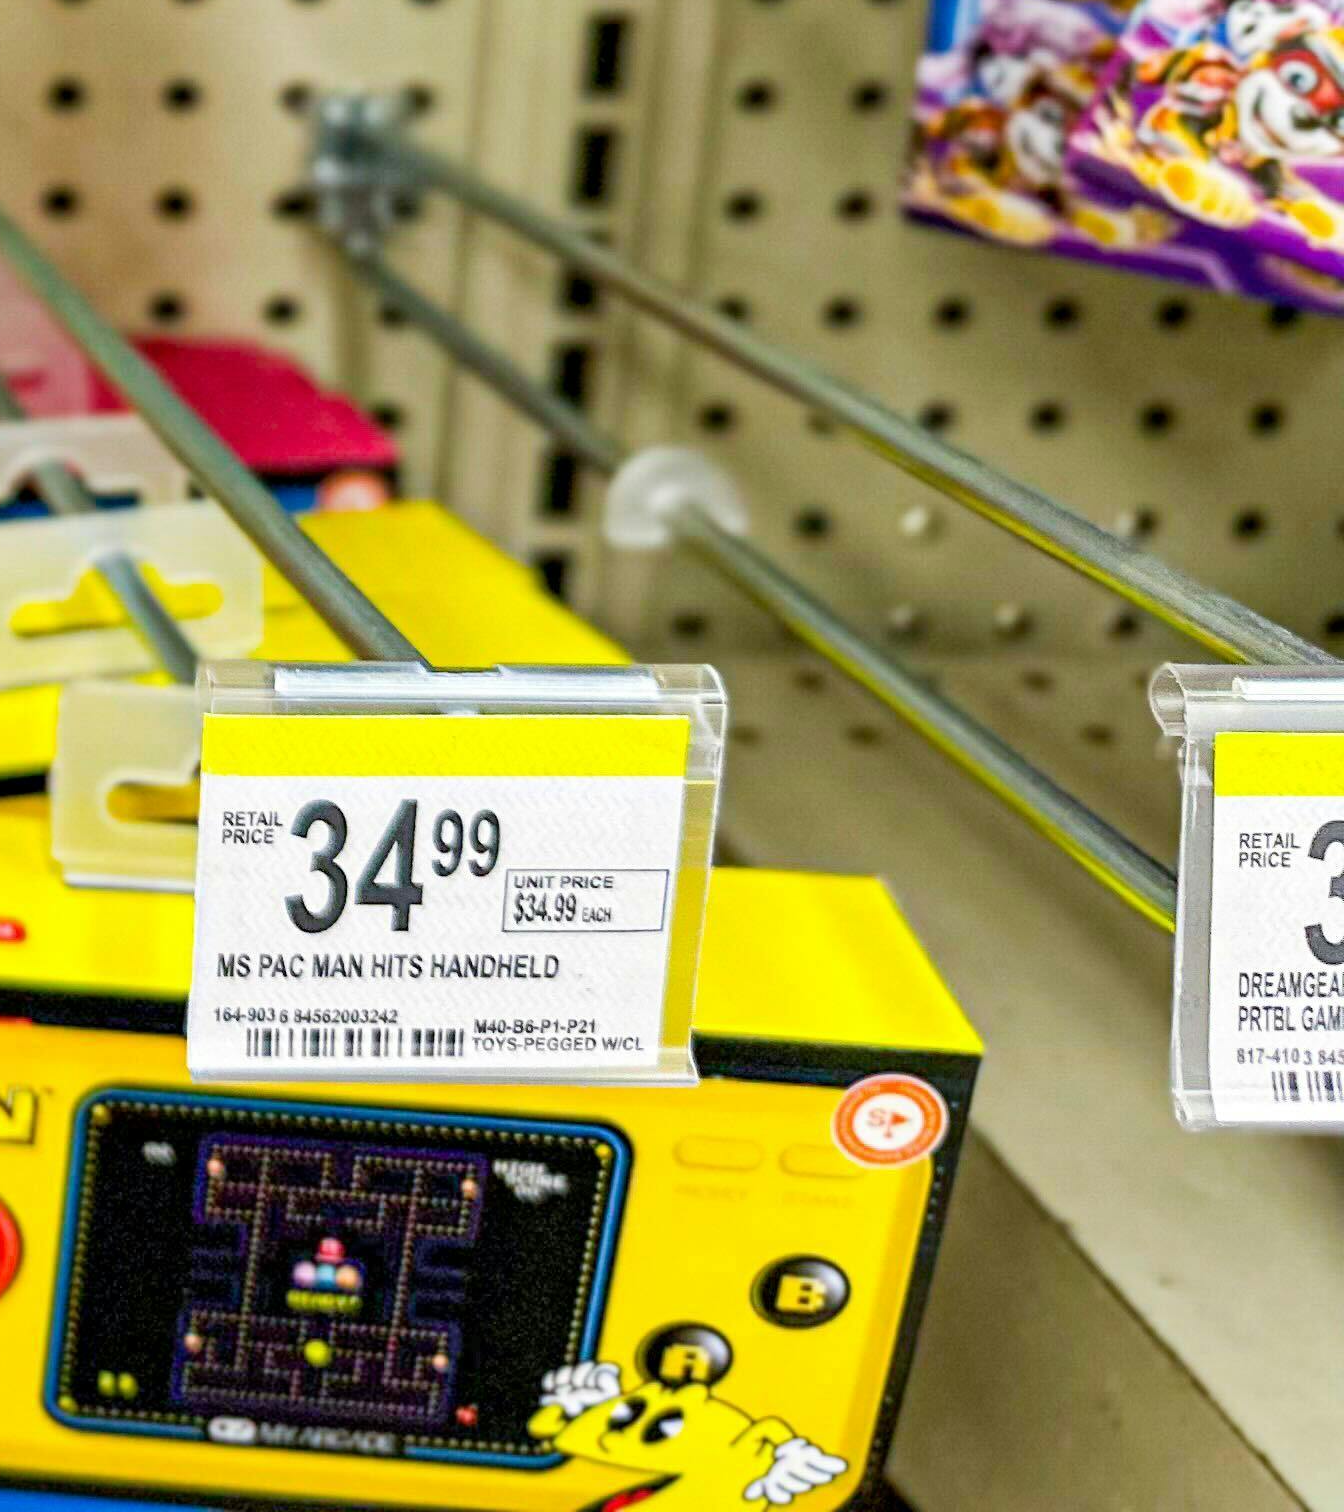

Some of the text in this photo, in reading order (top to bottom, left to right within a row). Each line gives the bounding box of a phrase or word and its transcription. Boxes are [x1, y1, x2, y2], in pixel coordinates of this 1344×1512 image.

[221, 810, 284, 828] RETAIL
[221, 828, 275, 845] PRICE
[1238, 832, 1302, 850] RETAIL
[1238, 851, 1292, 869] PRICE
[513, 875, 615, 890] UNIT PRICE
[512, 892, 613, 926] $34.99 EACH
[215, 954, 561, 980] MS PAC MAN HITS HANDHELD
[1237, 971, 1344, 999] DREAMGEA
[1237, 1004, 1344, 1032] PRTBL GAM
[471, 1037, 646, 1053] TOYS-PEGGED W/CL
[775, 1274, 827, 1315] B
